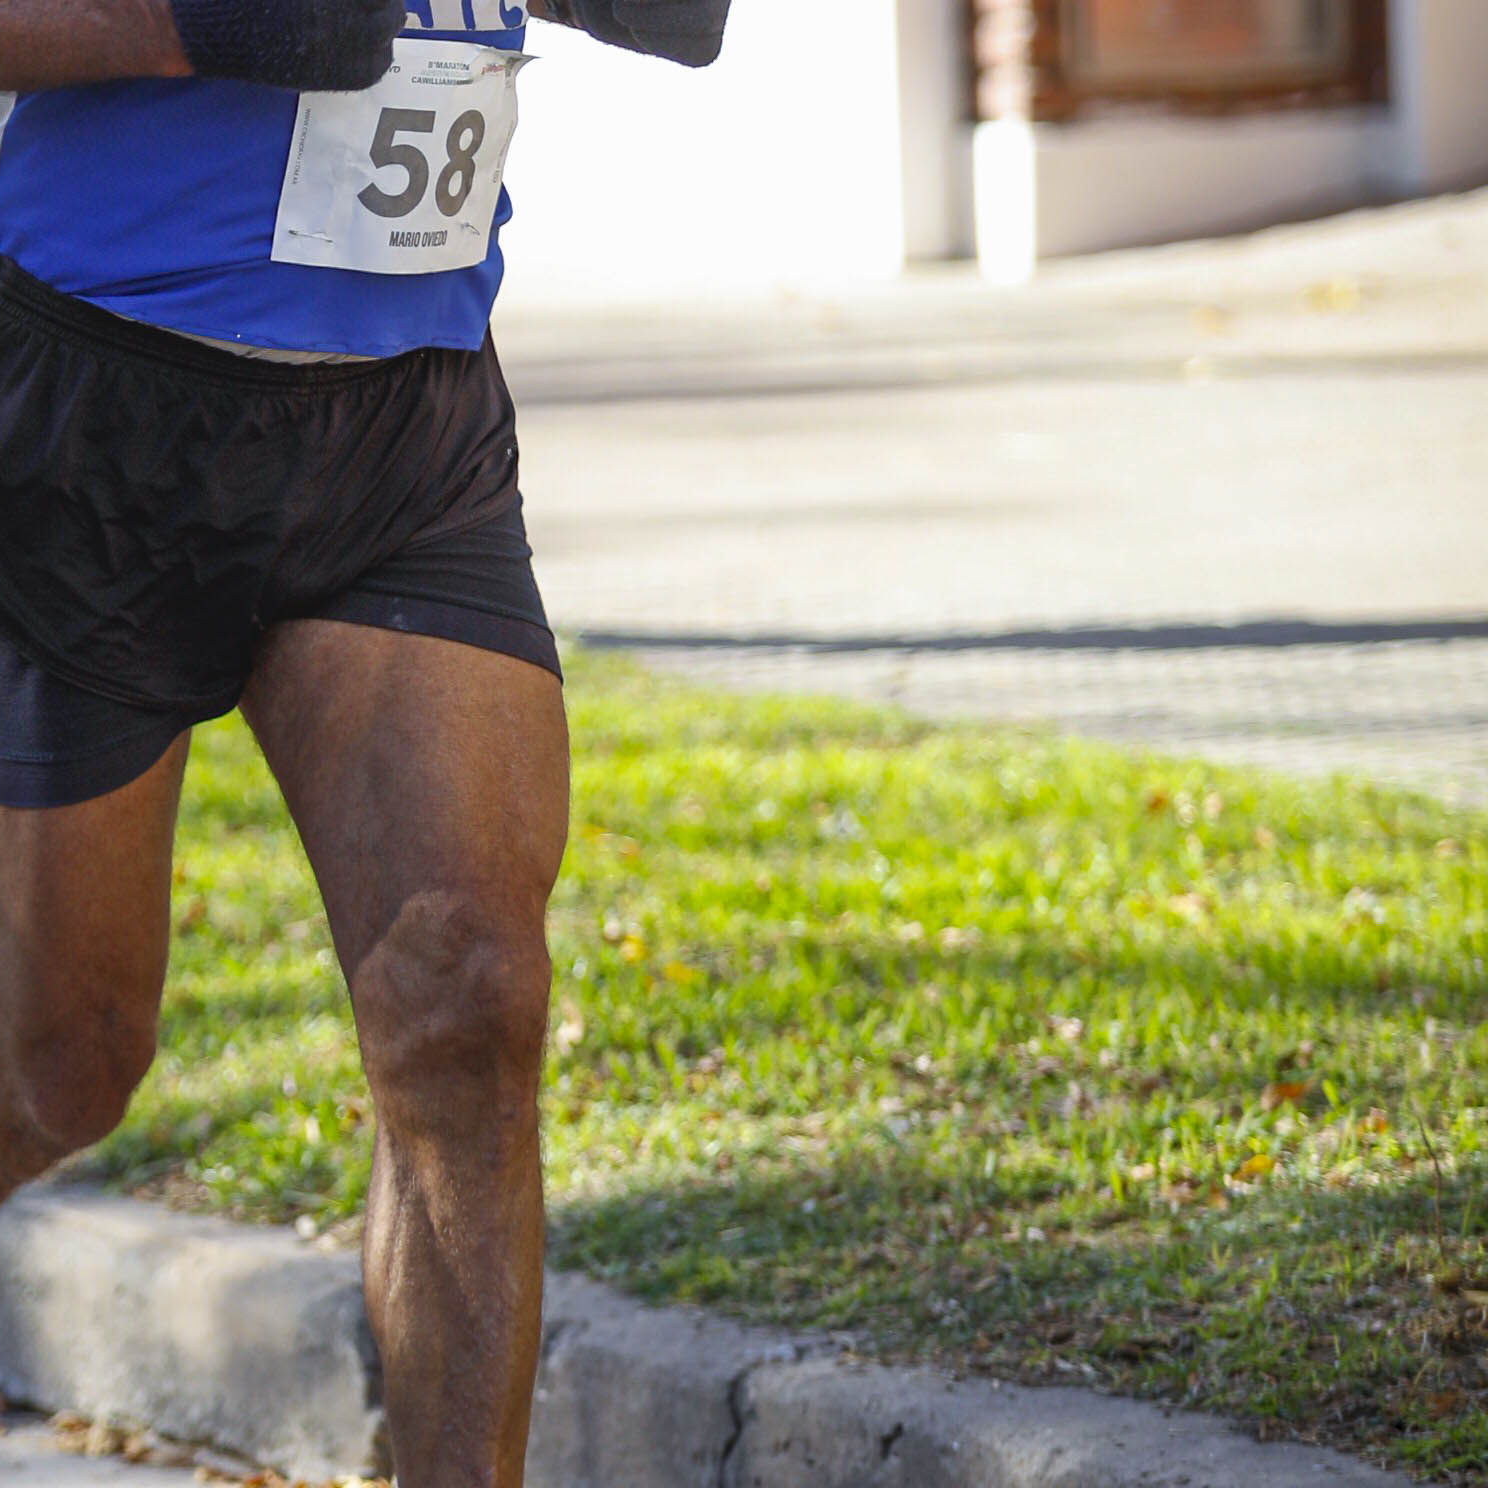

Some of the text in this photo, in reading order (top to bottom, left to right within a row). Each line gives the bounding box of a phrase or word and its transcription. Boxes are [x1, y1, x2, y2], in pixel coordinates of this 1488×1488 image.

[356, 107, 486, 218] 58
[389, 230, 448, 248] MARIO OVIEDO
